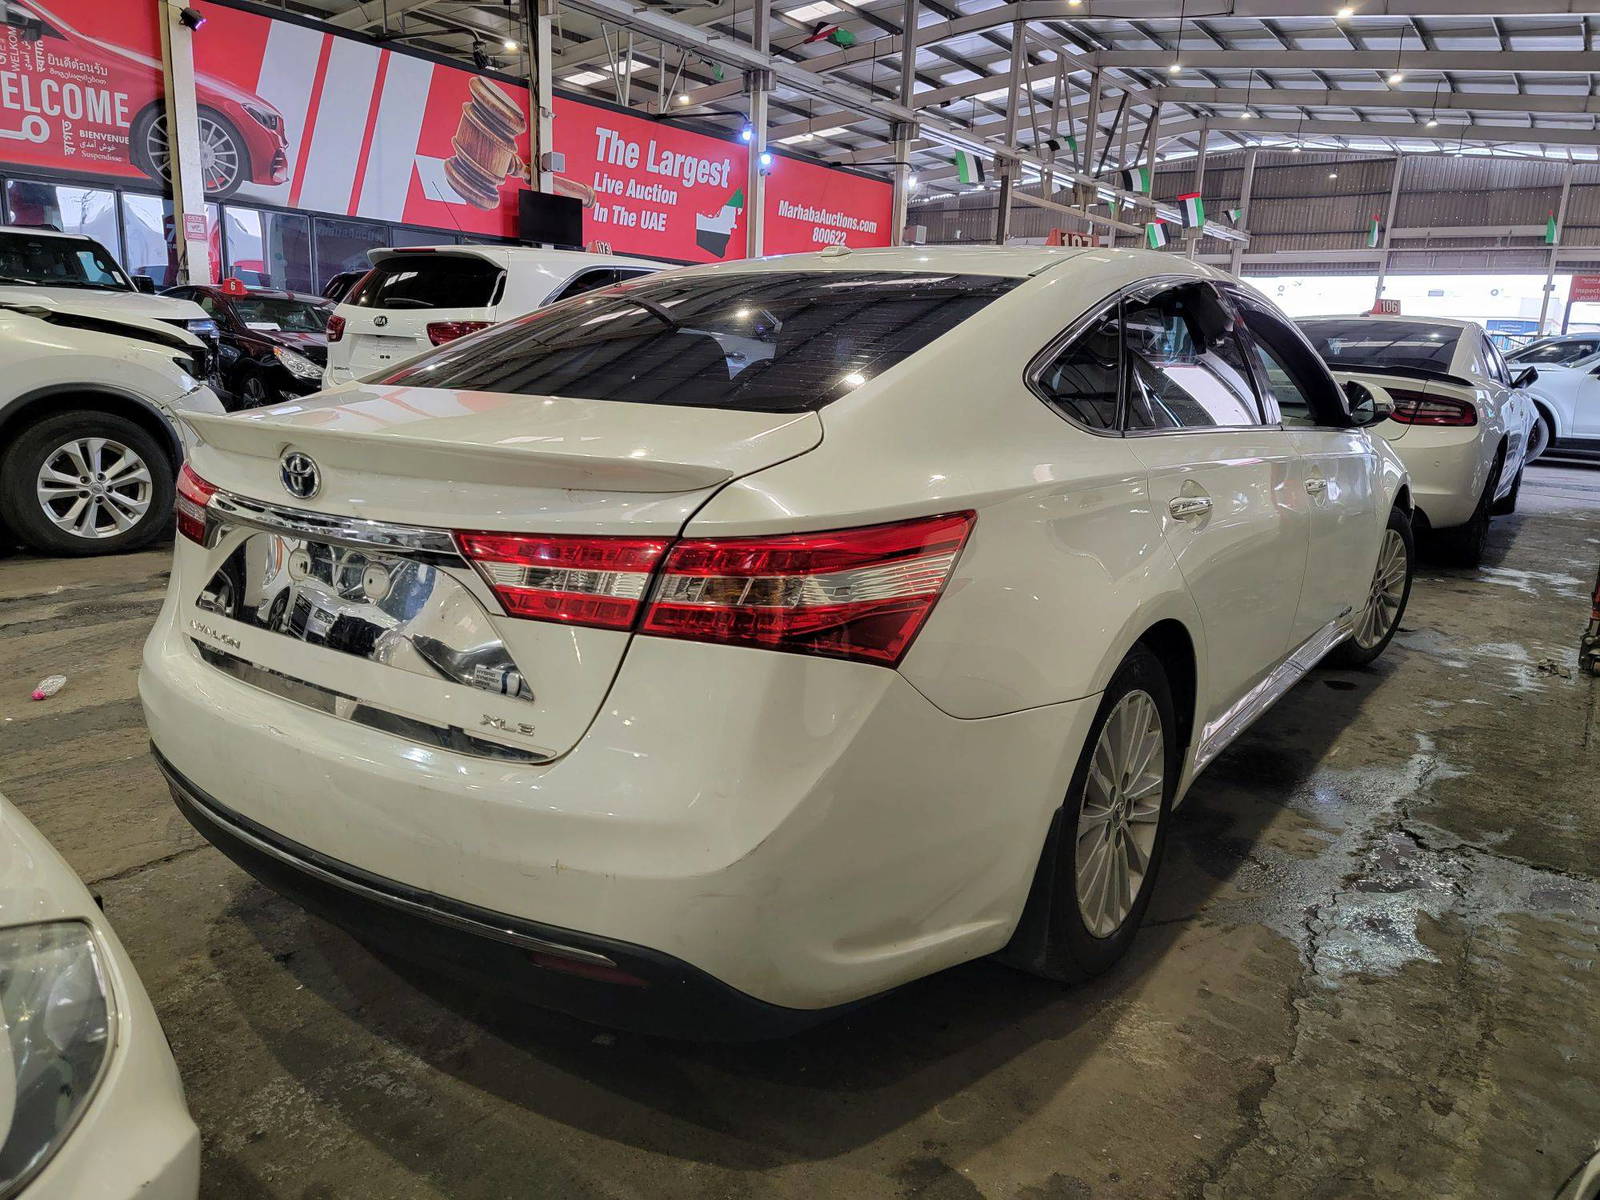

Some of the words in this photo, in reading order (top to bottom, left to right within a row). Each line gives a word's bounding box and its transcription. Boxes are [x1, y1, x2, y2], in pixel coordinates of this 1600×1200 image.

[8, 26, 20, 72] WELKOM
[0, 71, 131, 128] ELCOME
[79, 129, 130, 144] BIENVENUE
[81, 150, 123, 162] Suspendisse
[595, 126, 640, 169] The
[646, 140, 731, 189] Largest
[593, 171, 624, 196] Live
[625, 178, 678, 206] Auction
[593, 202, 608, 223] In
[612, 205, 637, 228] The
[640, 210, 668, 232] UAE
[778, 199, 878, 234] MarhabaAuctions.com
[812, 226, 847, 246] 800622
[1381, 300, 1398, 313] 106
